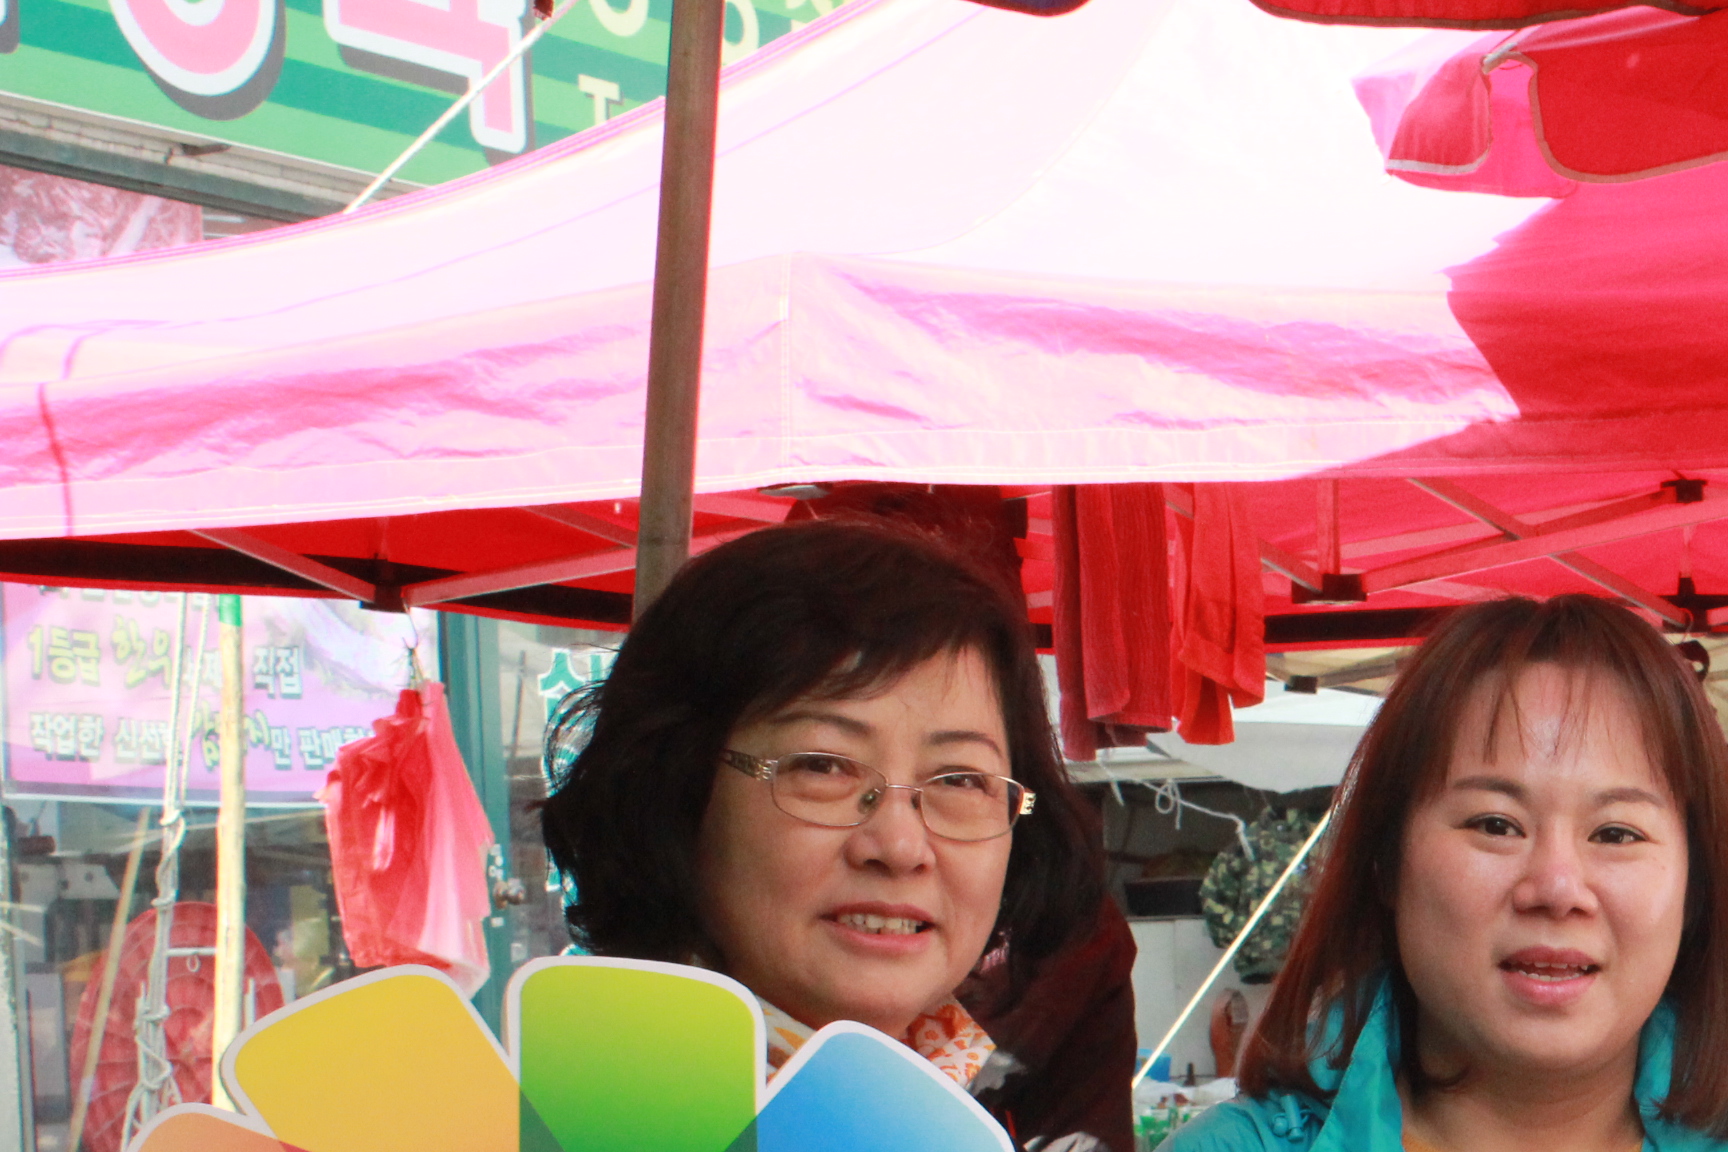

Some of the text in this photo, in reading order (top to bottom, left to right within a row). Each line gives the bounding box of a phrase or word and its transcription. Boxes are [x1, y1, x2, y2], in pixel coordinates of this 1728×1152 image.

[27, 624, 102, 687] 1등급
[111, 613, 173, 690] 한우
[252, 645, 304, 700] 직접
[29, 712, 104, 762] 작업한
